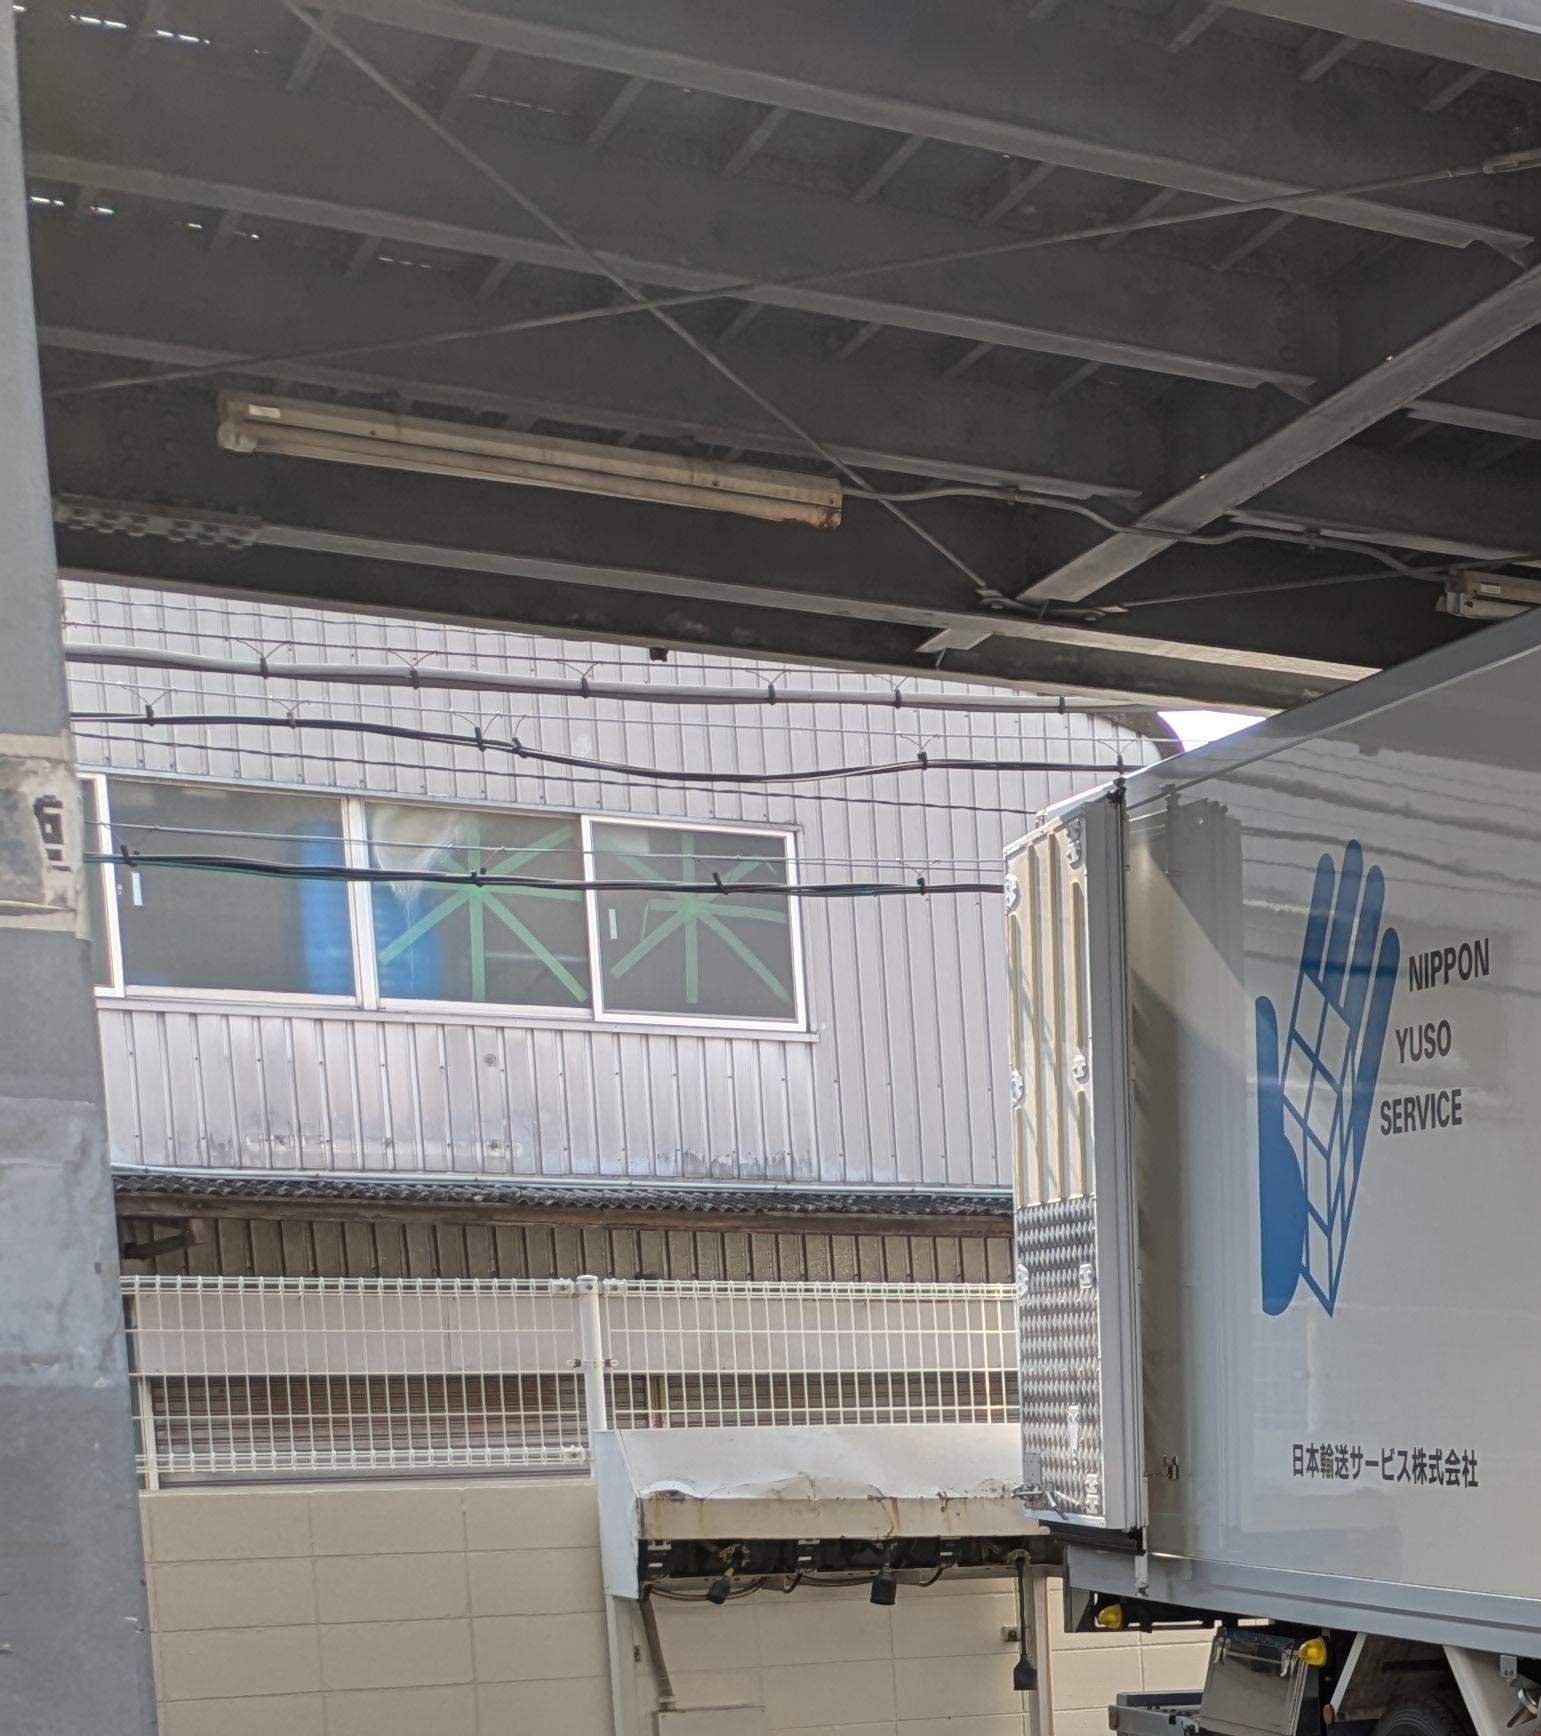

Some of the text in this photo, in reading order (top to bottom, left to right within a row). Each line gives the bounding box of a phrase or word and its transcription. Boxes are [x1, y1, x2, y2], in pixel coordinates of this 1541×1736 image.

[1409, 938, 1490, 992] NIPPON
[1395, 1019, 1452, 1064] YUSO
[1380, 1088, 1463, 1136] SERVICE
[1292, 1442, 1479, 1488] 日本輸送サービス株式会社
